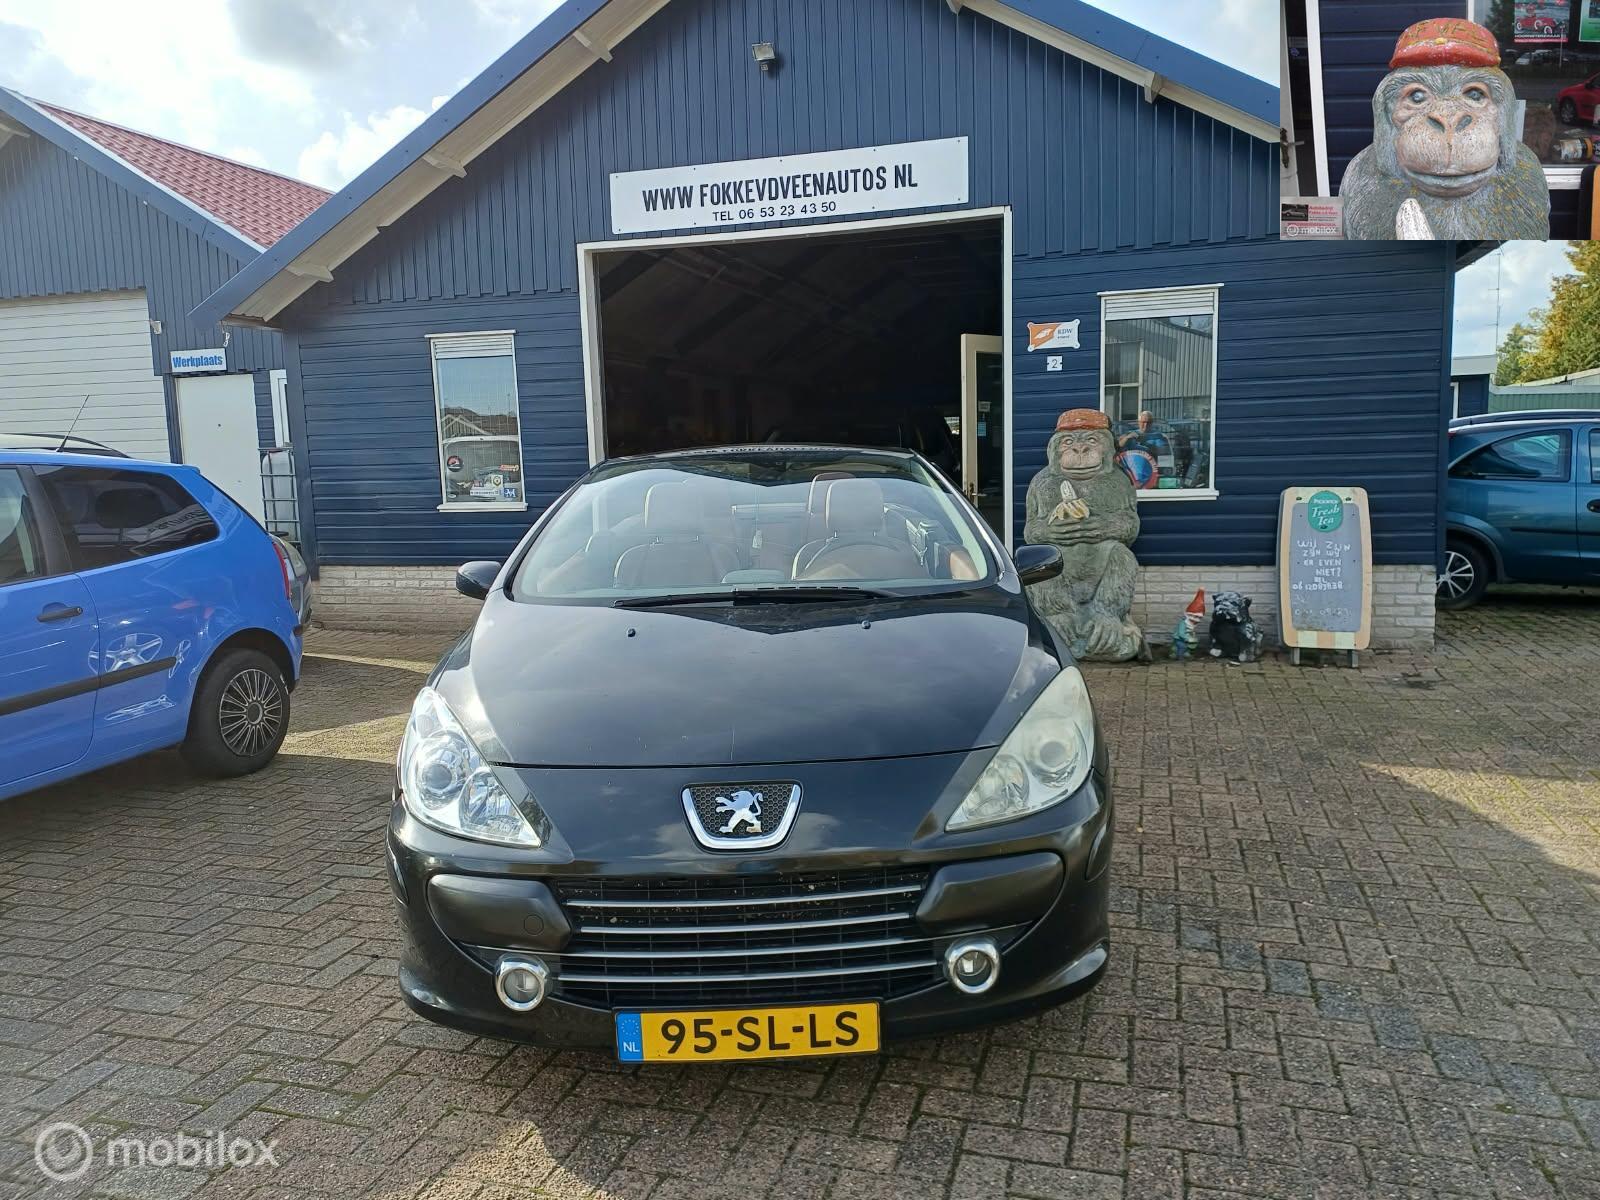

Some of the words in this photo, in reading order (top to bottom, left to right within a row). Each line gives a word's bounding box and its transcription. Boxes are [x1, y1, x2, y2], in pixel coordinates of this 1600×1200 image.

[699, 165, 887, 208] FOKKEVDVEENAUTOS
[894, 163, 918, 189] NL
[712, 210, 734, 222] TEL
[738, 208, 755, 219] 06
[760, 206, 775, 218] 53
[780, 204, 795, 217] 23
[800, 203, 817, 214] 43
[821, 201, 836, 213] 50
[172, 355, 223, 368] Werkplaats
[1051, 358, 1058, 369] 2
[1311, 504, 1340, 518] Fresh
[1317, 516, 1334, 526] Tea
[661, 1010, 860, 1055] 95-SL-LS
[622, 1041, 640, 1053] NL
